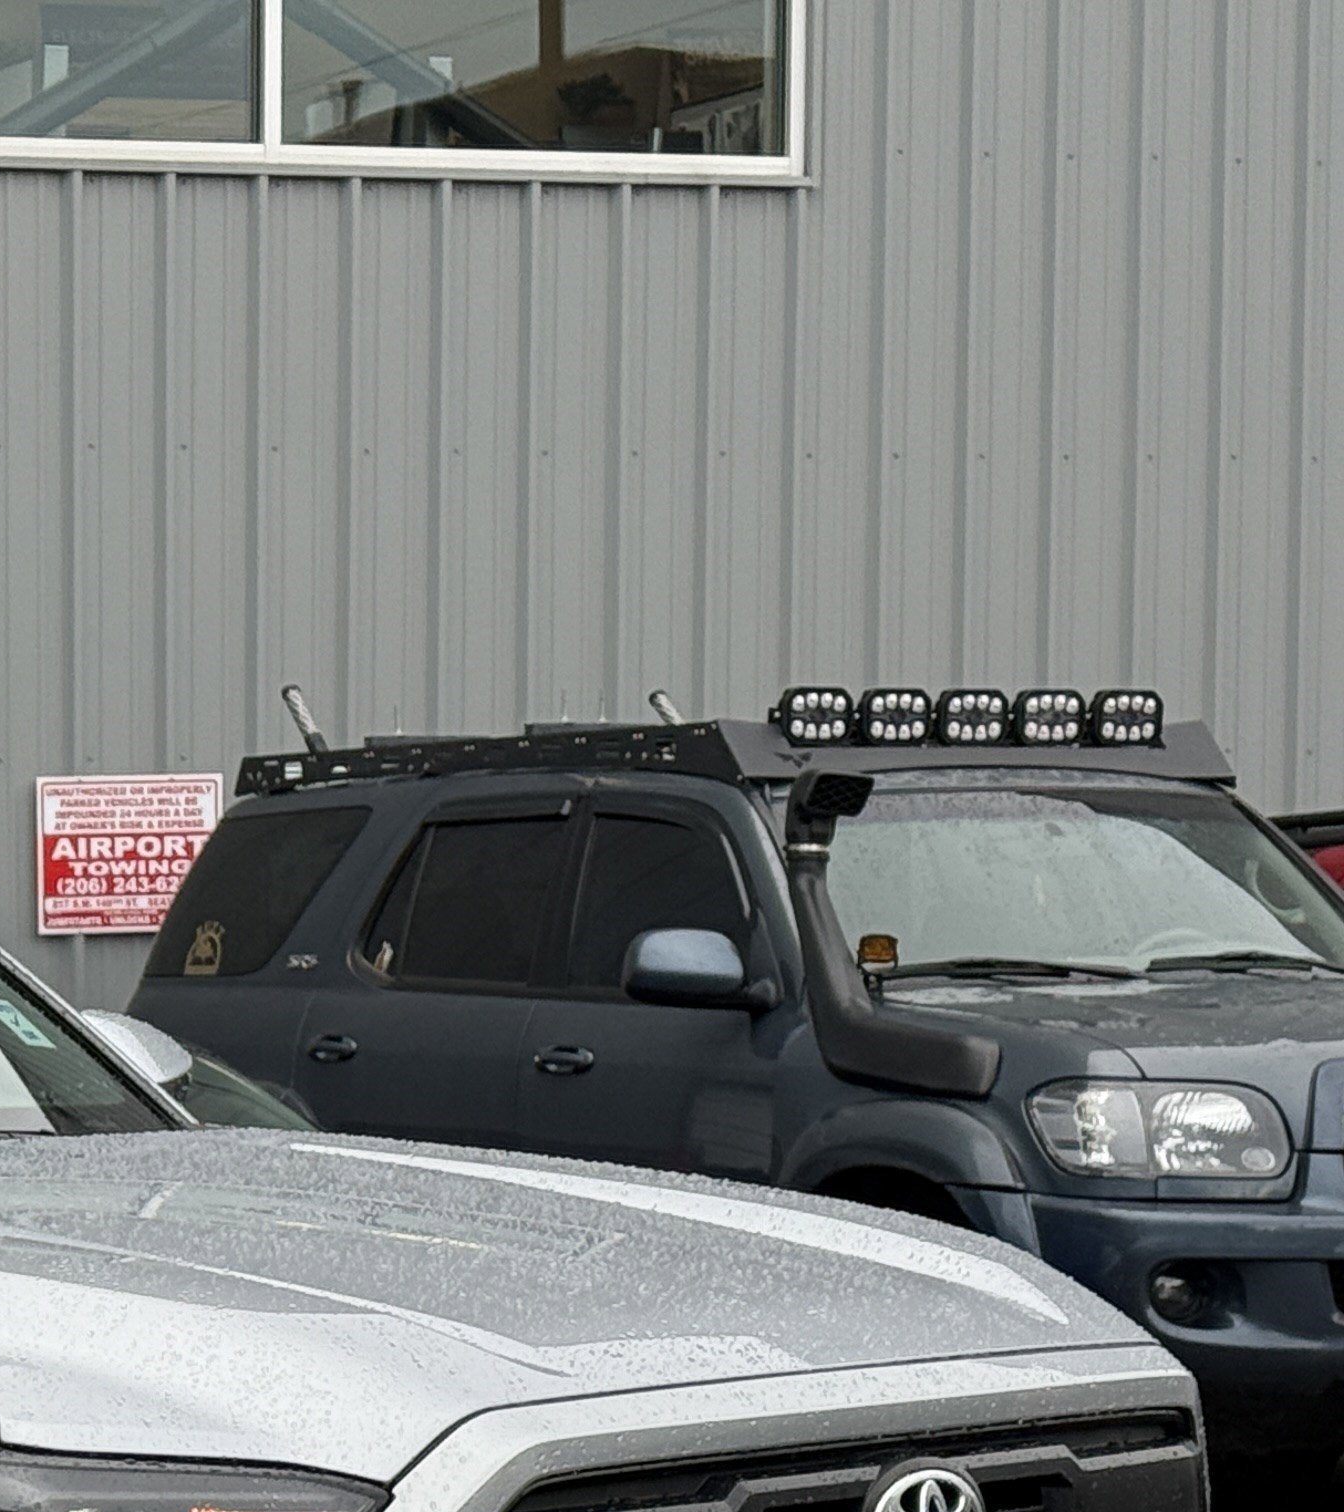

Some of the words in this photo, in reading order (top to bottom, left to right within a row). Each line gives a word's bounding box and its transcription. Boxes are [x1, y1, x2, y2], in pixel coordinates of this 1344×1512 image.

[51, 834, 208, 861] AIRPORT
[68, 858, 192, 877] TOWING
[56, 876, 107, 895] (206)
[112, 875, 184, 894] 243-62
